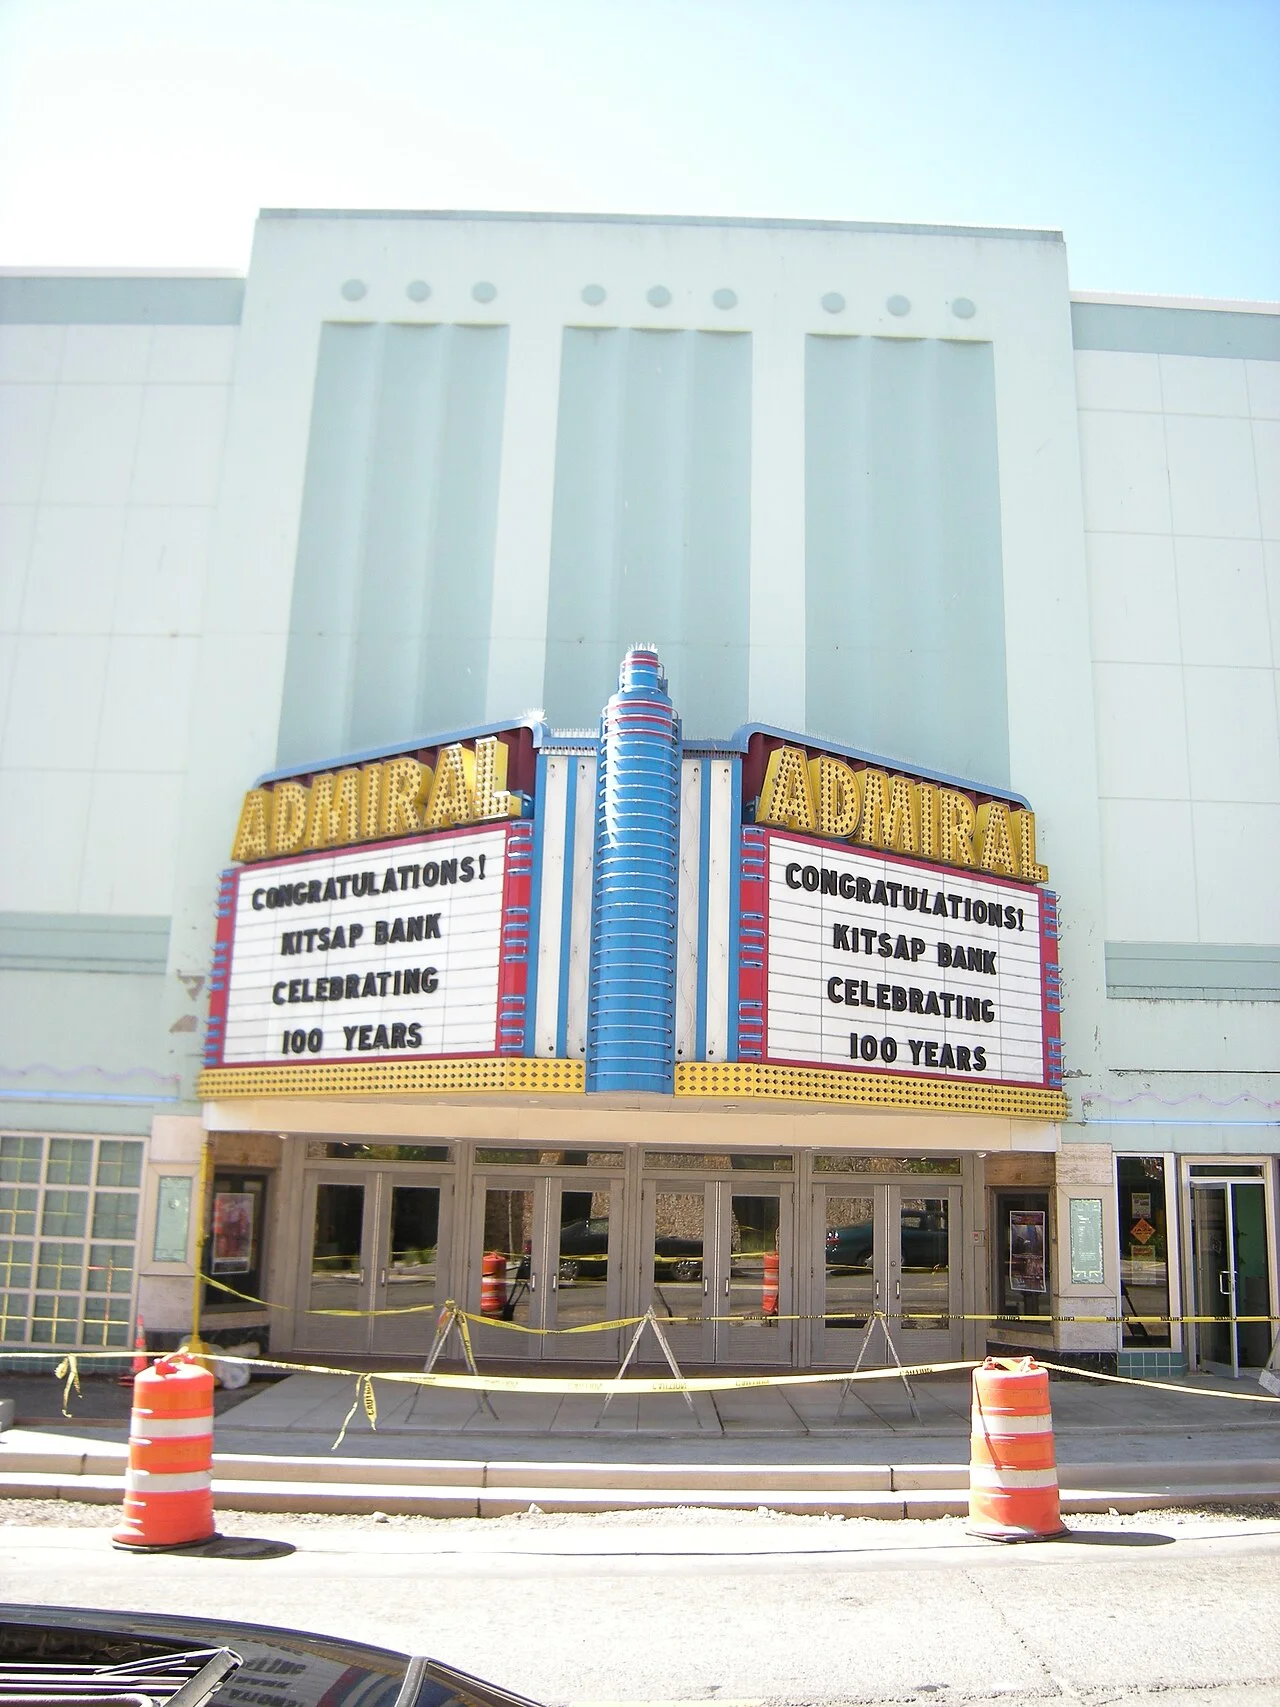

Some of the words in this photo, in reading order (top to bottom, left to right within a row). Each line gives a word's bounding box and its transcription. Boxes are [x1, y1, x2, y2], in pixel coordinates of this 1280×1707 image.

[231, 736, 521, 862] ADMIRAL
[755, 745, 1048, 883] ADMIRAL
[252, 854, 487, 911] CONGRATULATIONS!
[785, 862, 1025, 932] CONGRATULATIONS!
[280, 923, 364, 956] KITSAP
[374, 912, 442, 946] BANK
[832, 923, 926, 963] KITSAP
[937, 941, 997, 975] BANK
[272, 966, 439, 1005] CELEBRATING
[827, 976, 995, 1024] CELEBRATING
[282, 1028, 324, 1055] 100
[342, 1022, 423, 1051] YEARS
[849, 1032, 898, 1063] 100
[907, 1038, 988, 1072] YEARS
